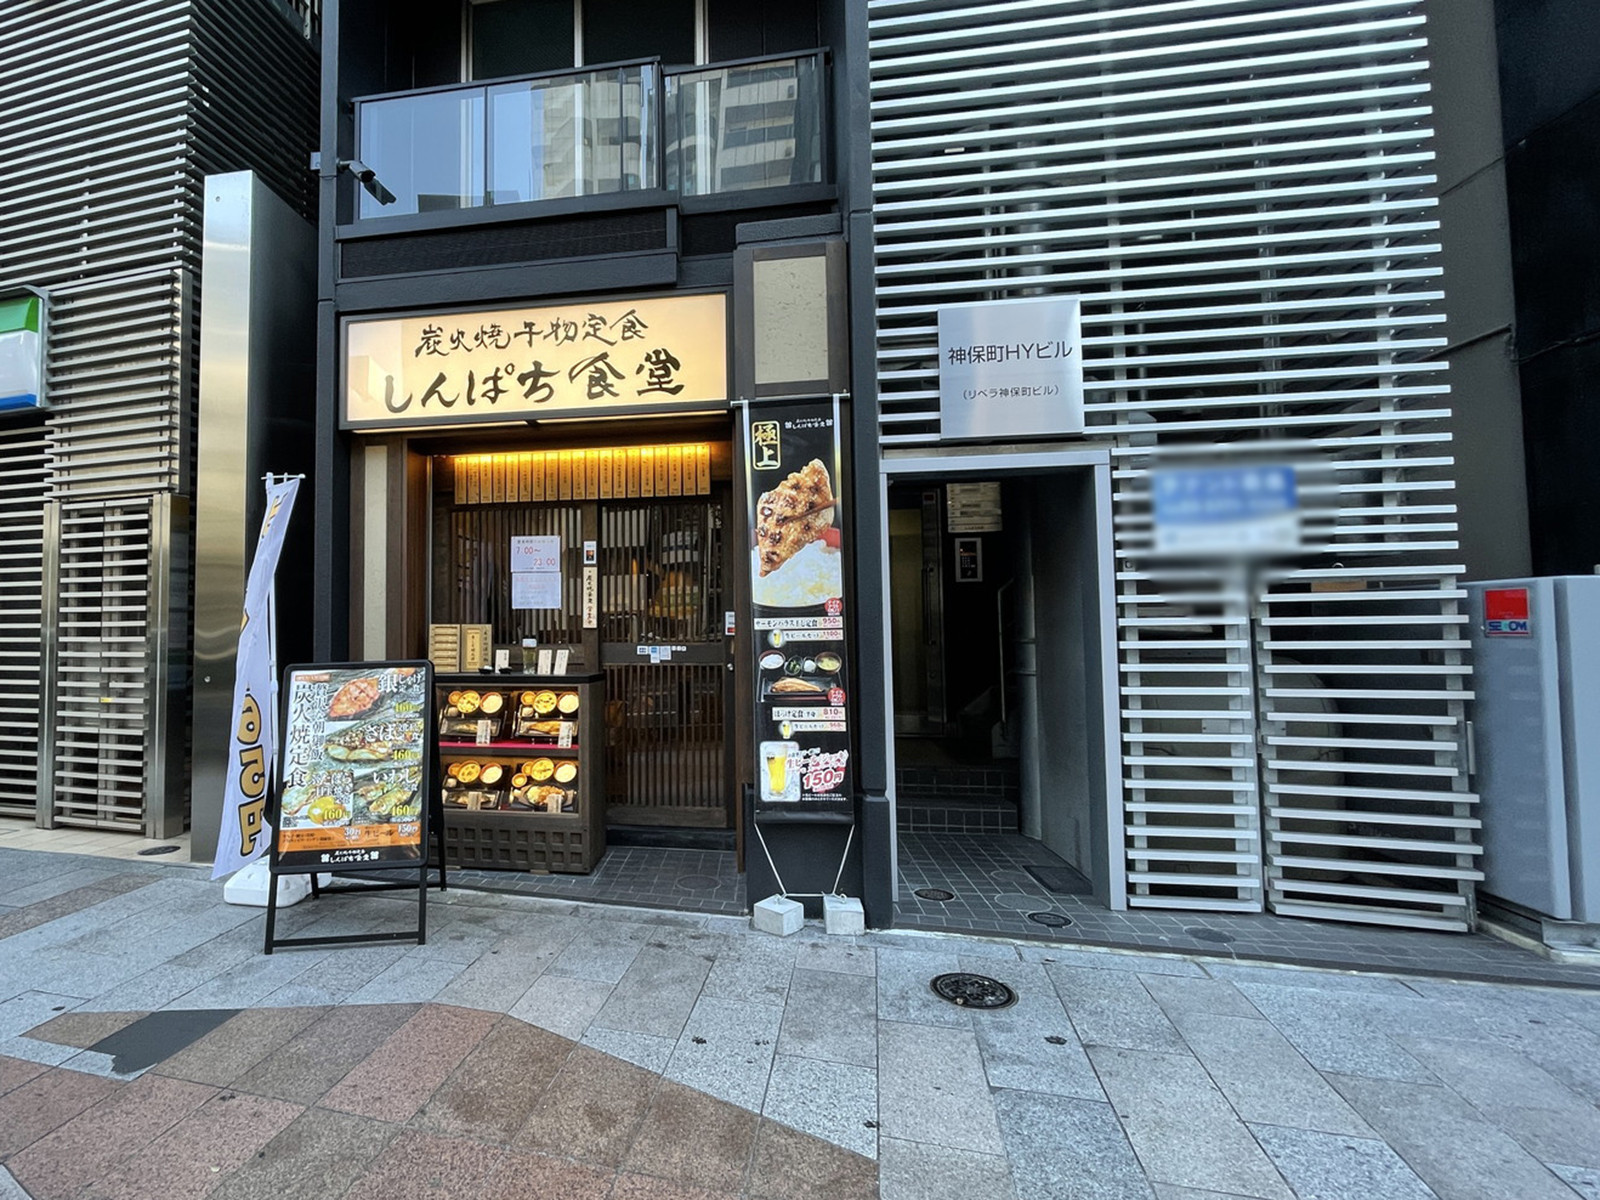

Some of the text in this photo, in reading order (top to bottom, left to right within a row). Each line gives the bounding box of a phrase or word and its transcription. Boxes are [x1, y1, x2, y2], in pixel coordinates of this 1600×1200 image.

[414, 308, 649, 357] 炭火焼干物定食
[948, 340, 1073, 365] 神保町HYビル
[384, 347, 685, 413] しんぱち食堂
[755, 423, 778, 468] 極上
[1488, 620, 1527, 631] SECOM
[287, 683, 312, 789] 炭火焼定食
[803, 769, 842, 789] 150円
